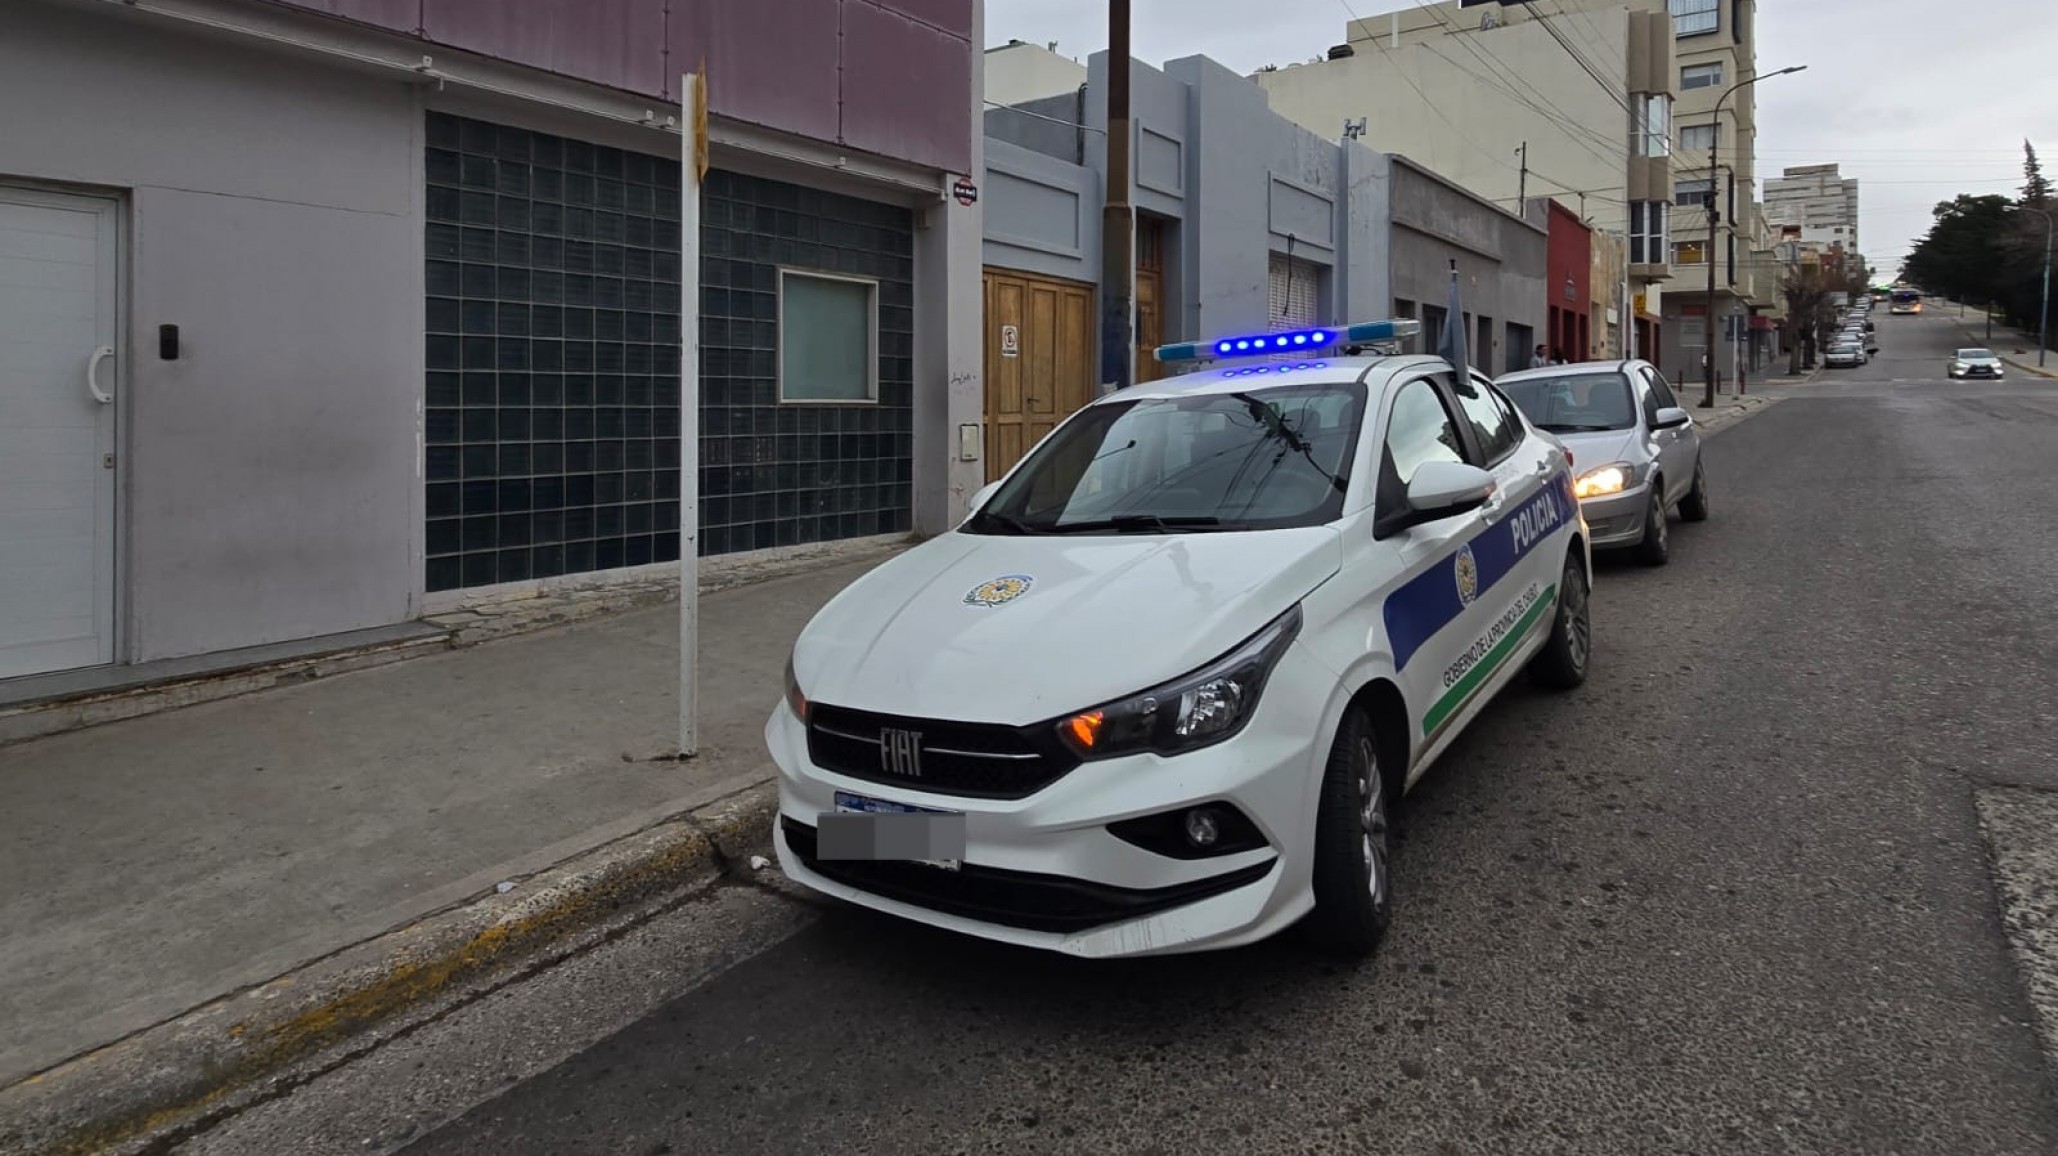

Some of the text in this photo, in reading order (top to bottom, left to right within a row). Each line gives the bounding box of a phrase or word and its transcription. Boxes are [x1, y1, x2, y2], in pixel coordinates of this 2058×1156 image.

[1510, 492, 1559, 555] POLICIA
[1443, 645, 1479, 688] GOBIERNO
[881, 727, 922, 776] FIAT
